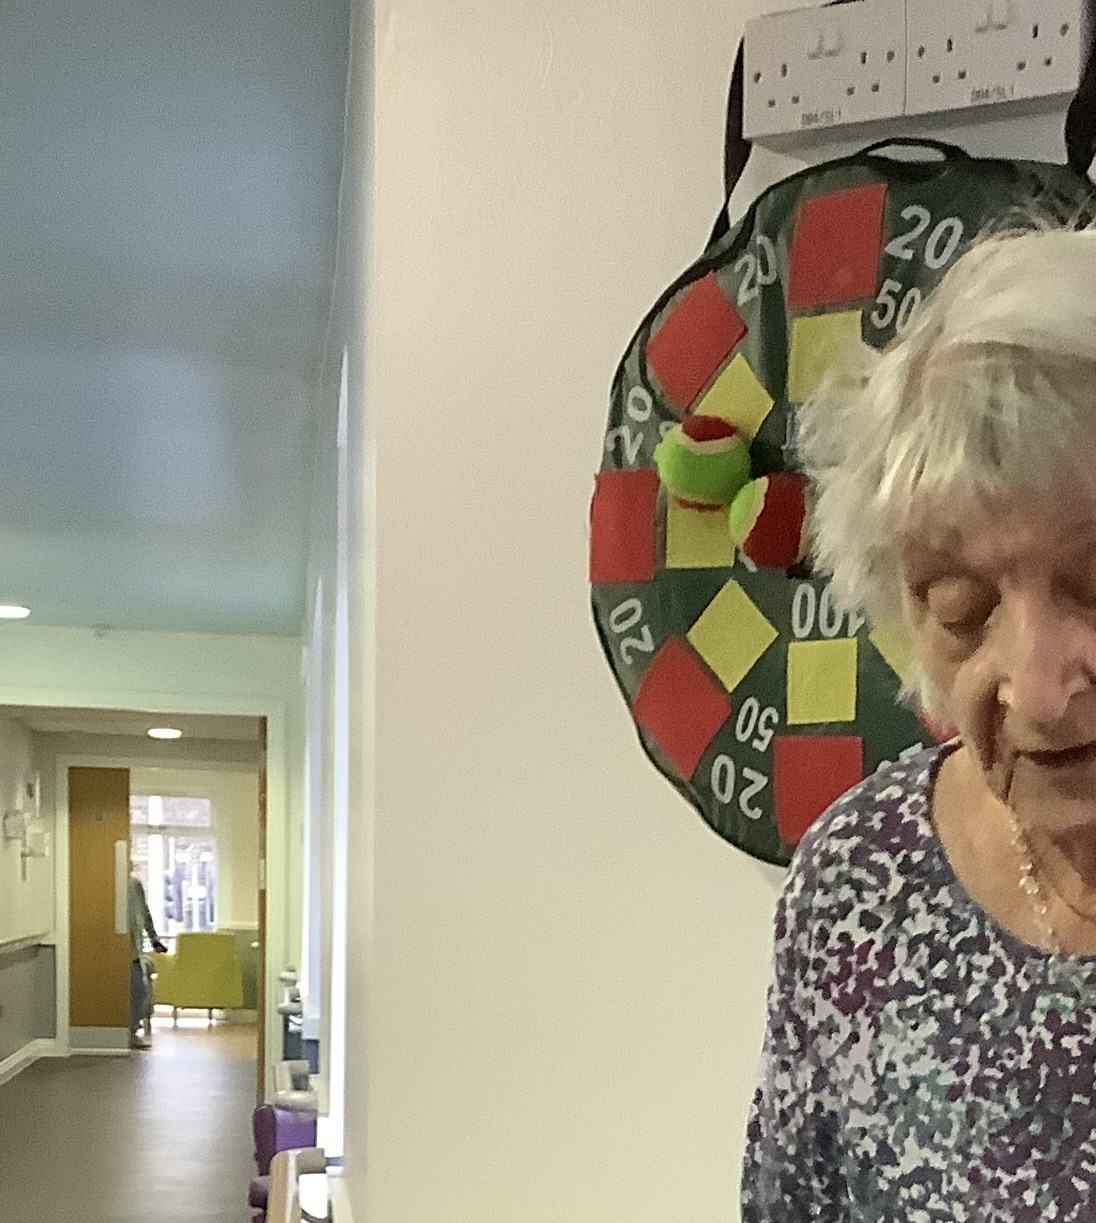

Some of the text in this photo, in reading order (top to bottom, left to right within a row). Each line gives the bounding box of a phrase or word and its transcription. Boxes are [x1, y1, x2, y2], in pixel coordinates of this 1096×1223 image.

[884, 204, 964, 270] 20
[733, 234, 778, 307] 20
[870, 278, 921, 332] 50
[605, 385, 653, 465] 20
[609, 598, 656, 665] 20
[735, 697, 779, 752] 50
[711, 754, 768, 820] 20
